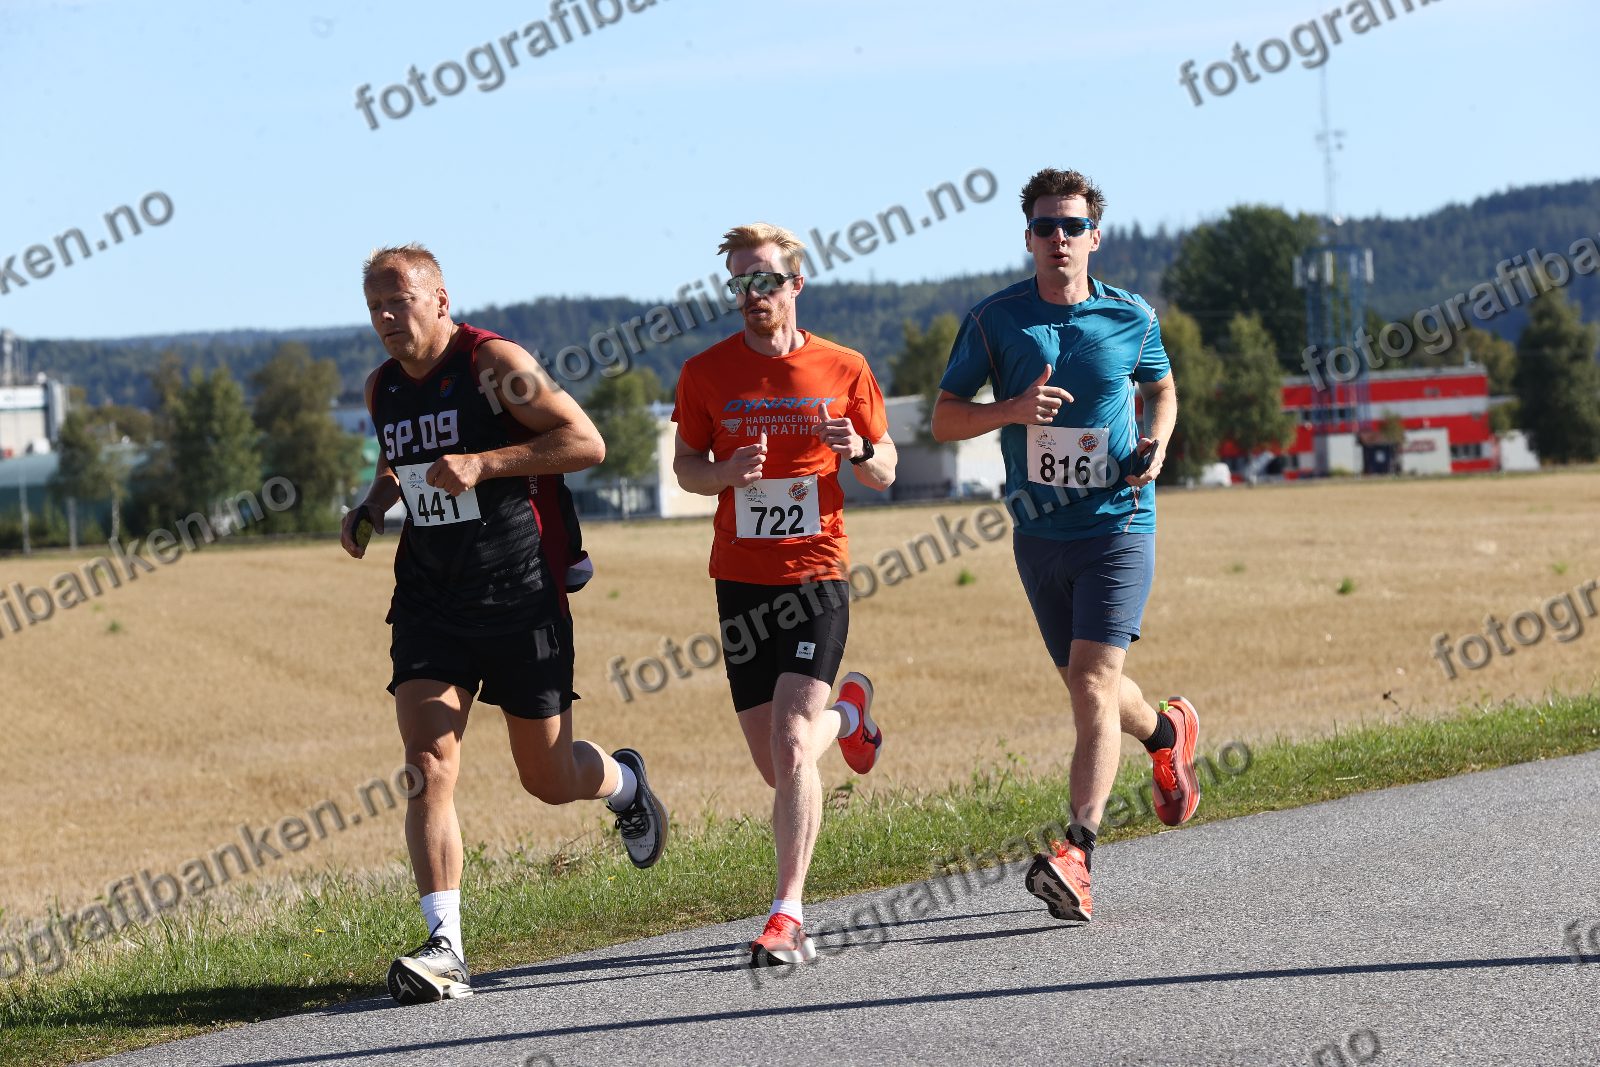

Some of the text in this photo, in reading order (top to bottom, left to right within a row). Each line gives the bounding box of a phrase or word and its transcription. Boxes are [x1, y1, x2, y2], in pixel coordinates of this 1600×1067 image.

[723, 397, 836, 413] DYNAFIT
[745, 414, 823, 424] HARDANGERVID
[383, 409, 459, 460] SP.09
[1040, 452, 1092, 486] 816
[418, 491, 460, 523] 441
[750, 505, 804, 535] 722
